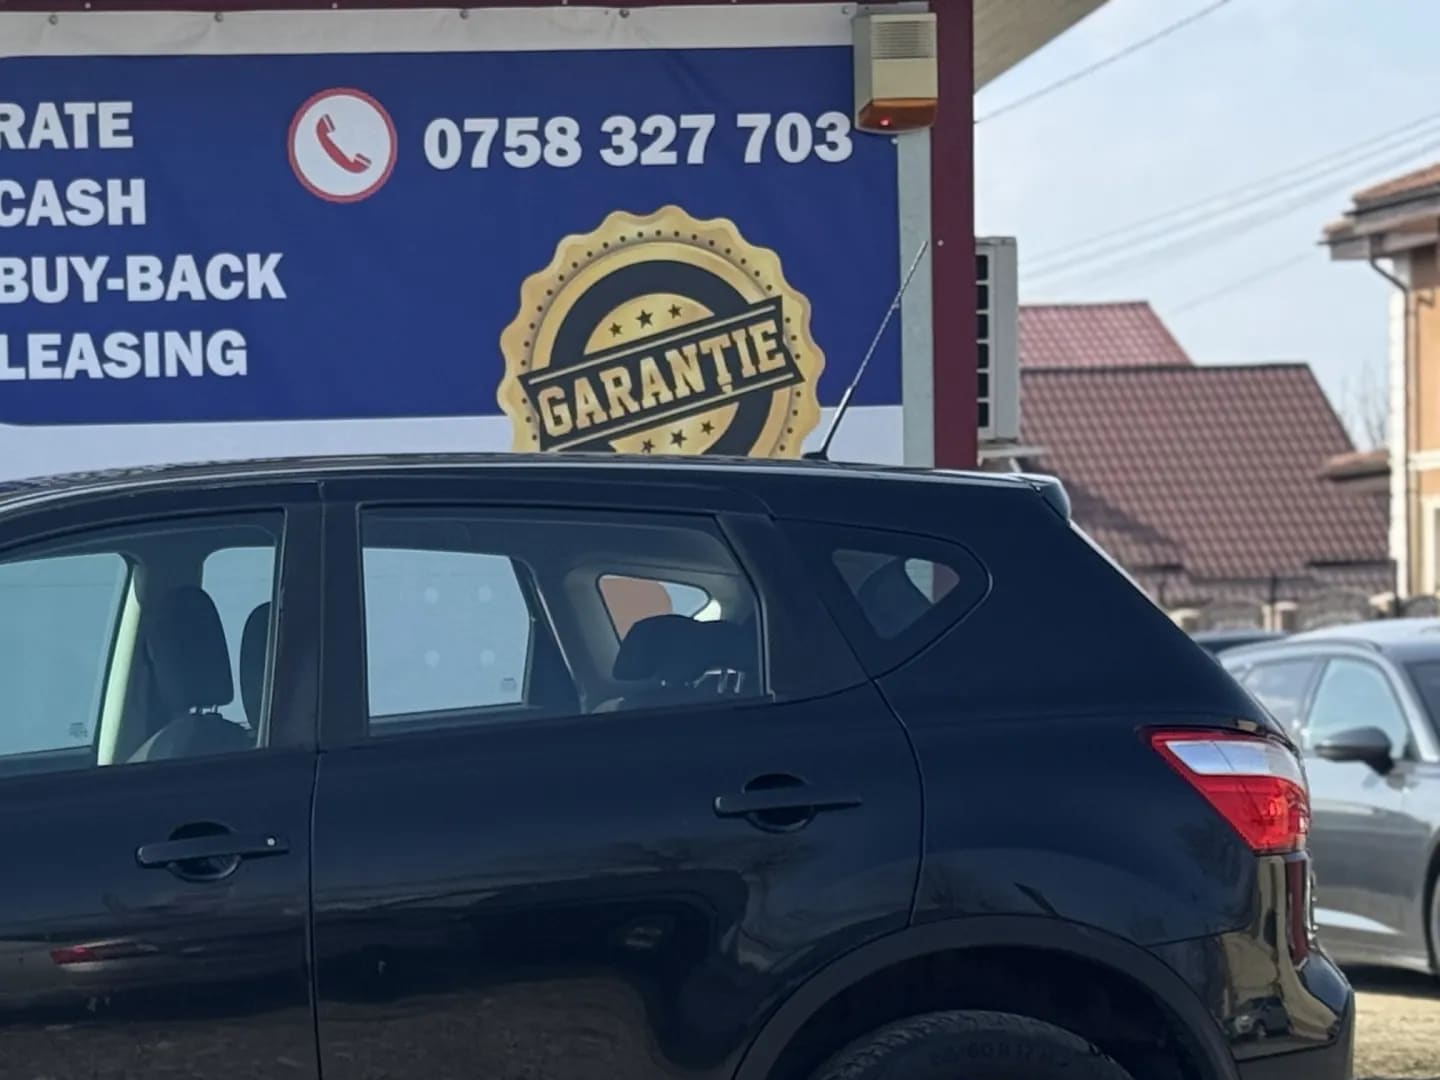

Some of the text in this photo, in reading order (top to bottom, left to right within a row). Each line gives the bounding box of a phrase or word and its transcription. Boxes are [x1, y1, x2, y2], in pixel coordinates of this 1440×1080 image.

[424, 111, 853, 170] 0758 327 703
